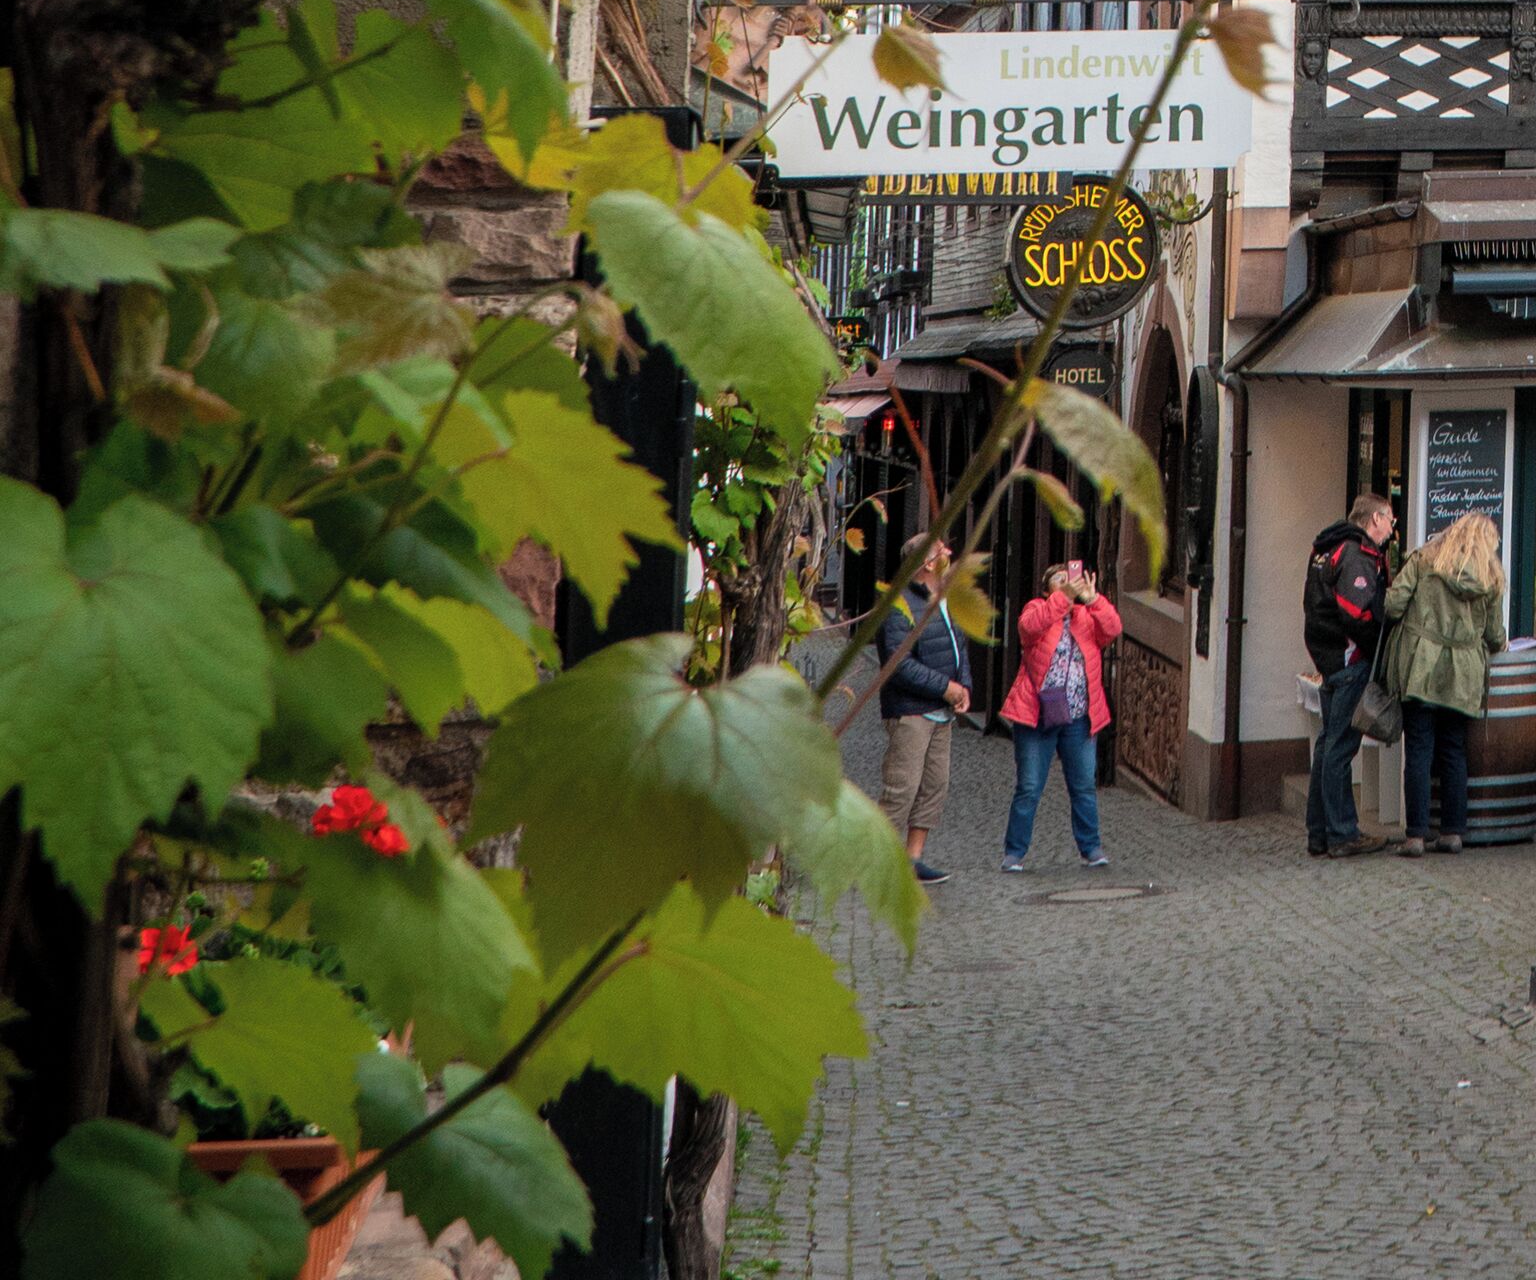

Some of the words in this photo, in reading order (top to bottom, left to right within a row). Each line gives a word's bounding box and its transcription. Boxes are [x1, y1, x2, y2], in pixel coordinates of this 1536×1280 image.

[1000, 43, 1204, 80] Lindenwirt
[810, 90, 1205, 167] Weingarten
[1025, 236, 1147, 287] SCHLOSS
[1055, 368, 1105, 384] HOTEL
